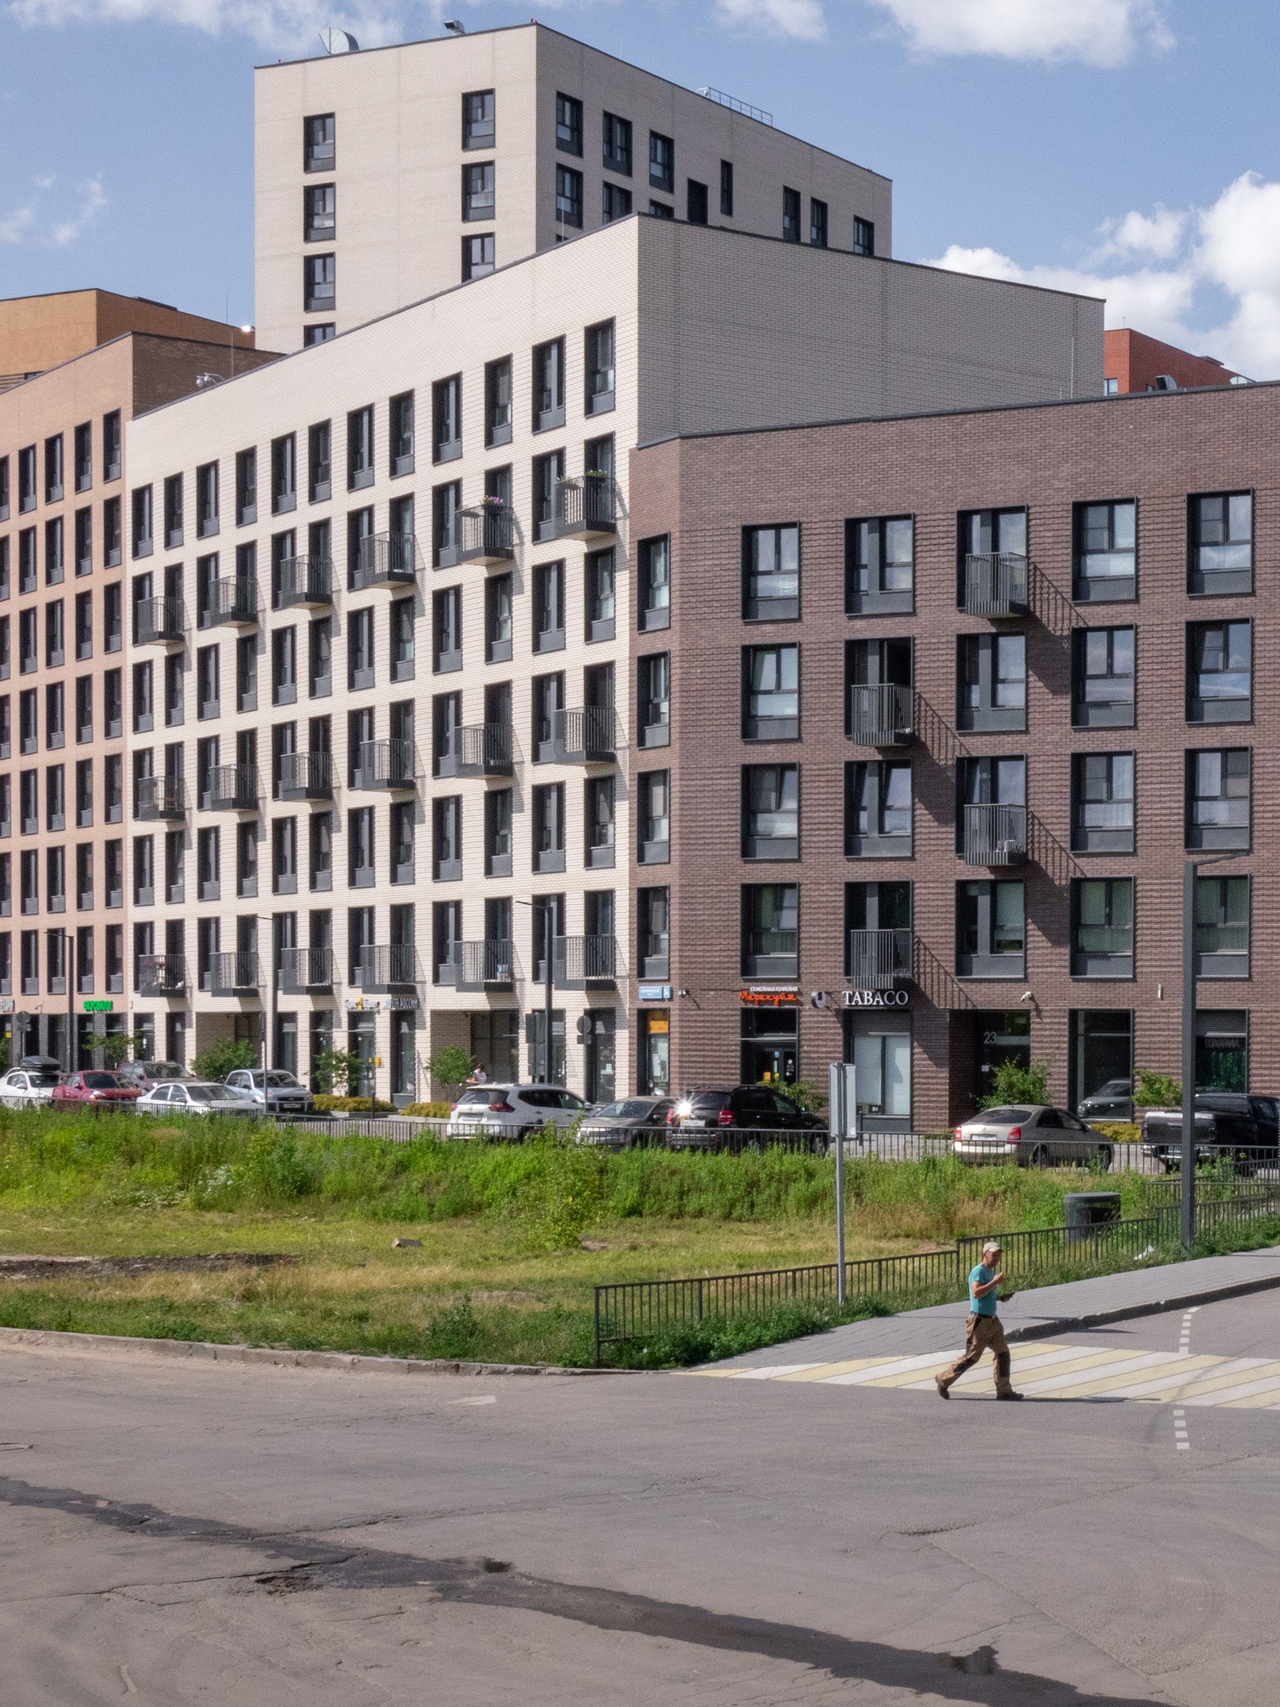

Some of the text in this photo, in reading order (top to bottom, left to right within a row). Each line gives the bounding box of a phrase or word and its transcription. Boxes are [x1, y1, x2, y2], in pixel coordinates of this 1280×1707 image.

[739, 990, 798, 1006] Маракуйя
[842, 990, 909, 1006] TABACO
[984, 1031, 997, 1044] 23
